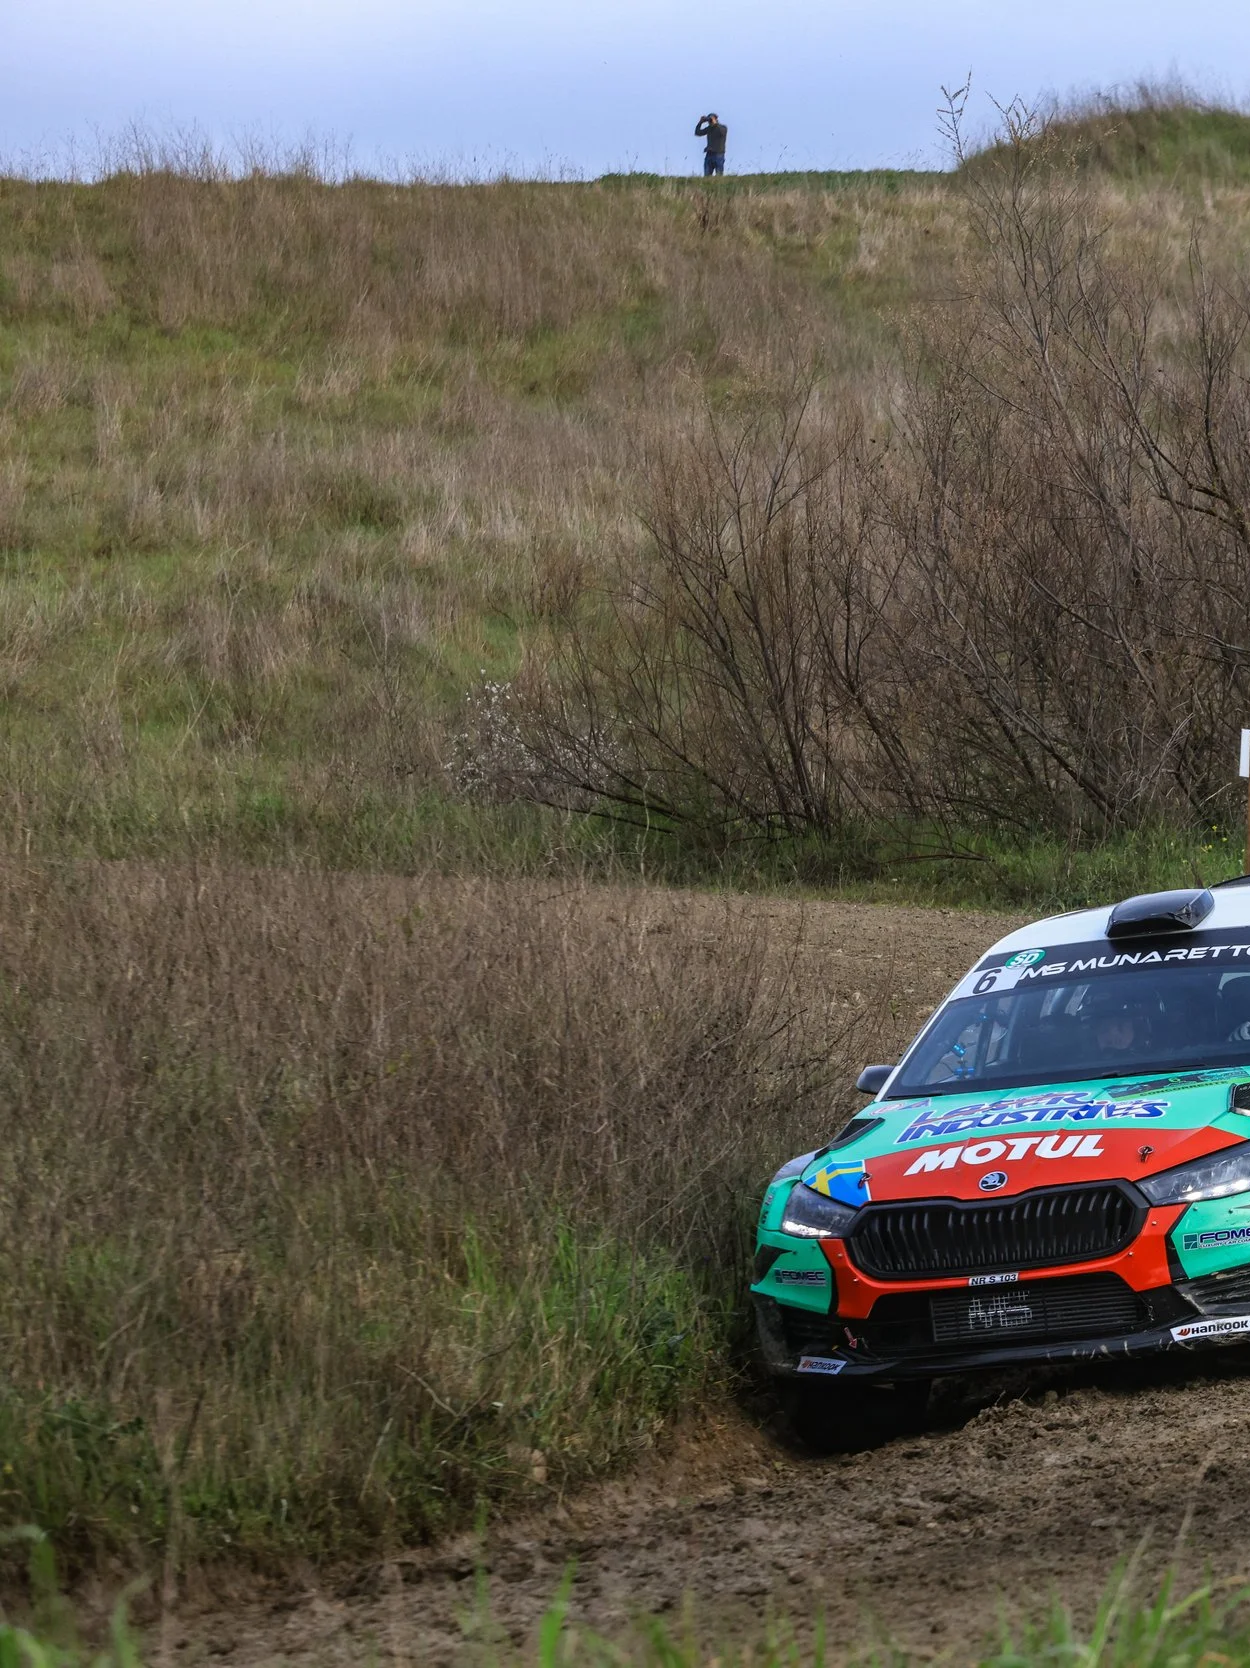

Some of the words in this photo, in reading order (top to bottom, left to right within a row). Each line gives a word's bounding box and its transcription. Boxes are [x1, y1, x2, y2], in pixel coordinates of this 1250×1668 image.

[1011, 953, 1040, 967] SD
[1020, 962, 1068, 980] MS
[972, 968, 1002, 994] 6
[895, 1100, 1169, 1145] INDUSTRIES
[903, 1135, 1104, 1176] MOTUL
[782, 1270, 826, 1281] FOMEC
[971, 1277, 986, 1286] NR
[989, 1275, 996, 1283] S
[1000, 1274, 1017, 1282] 103
